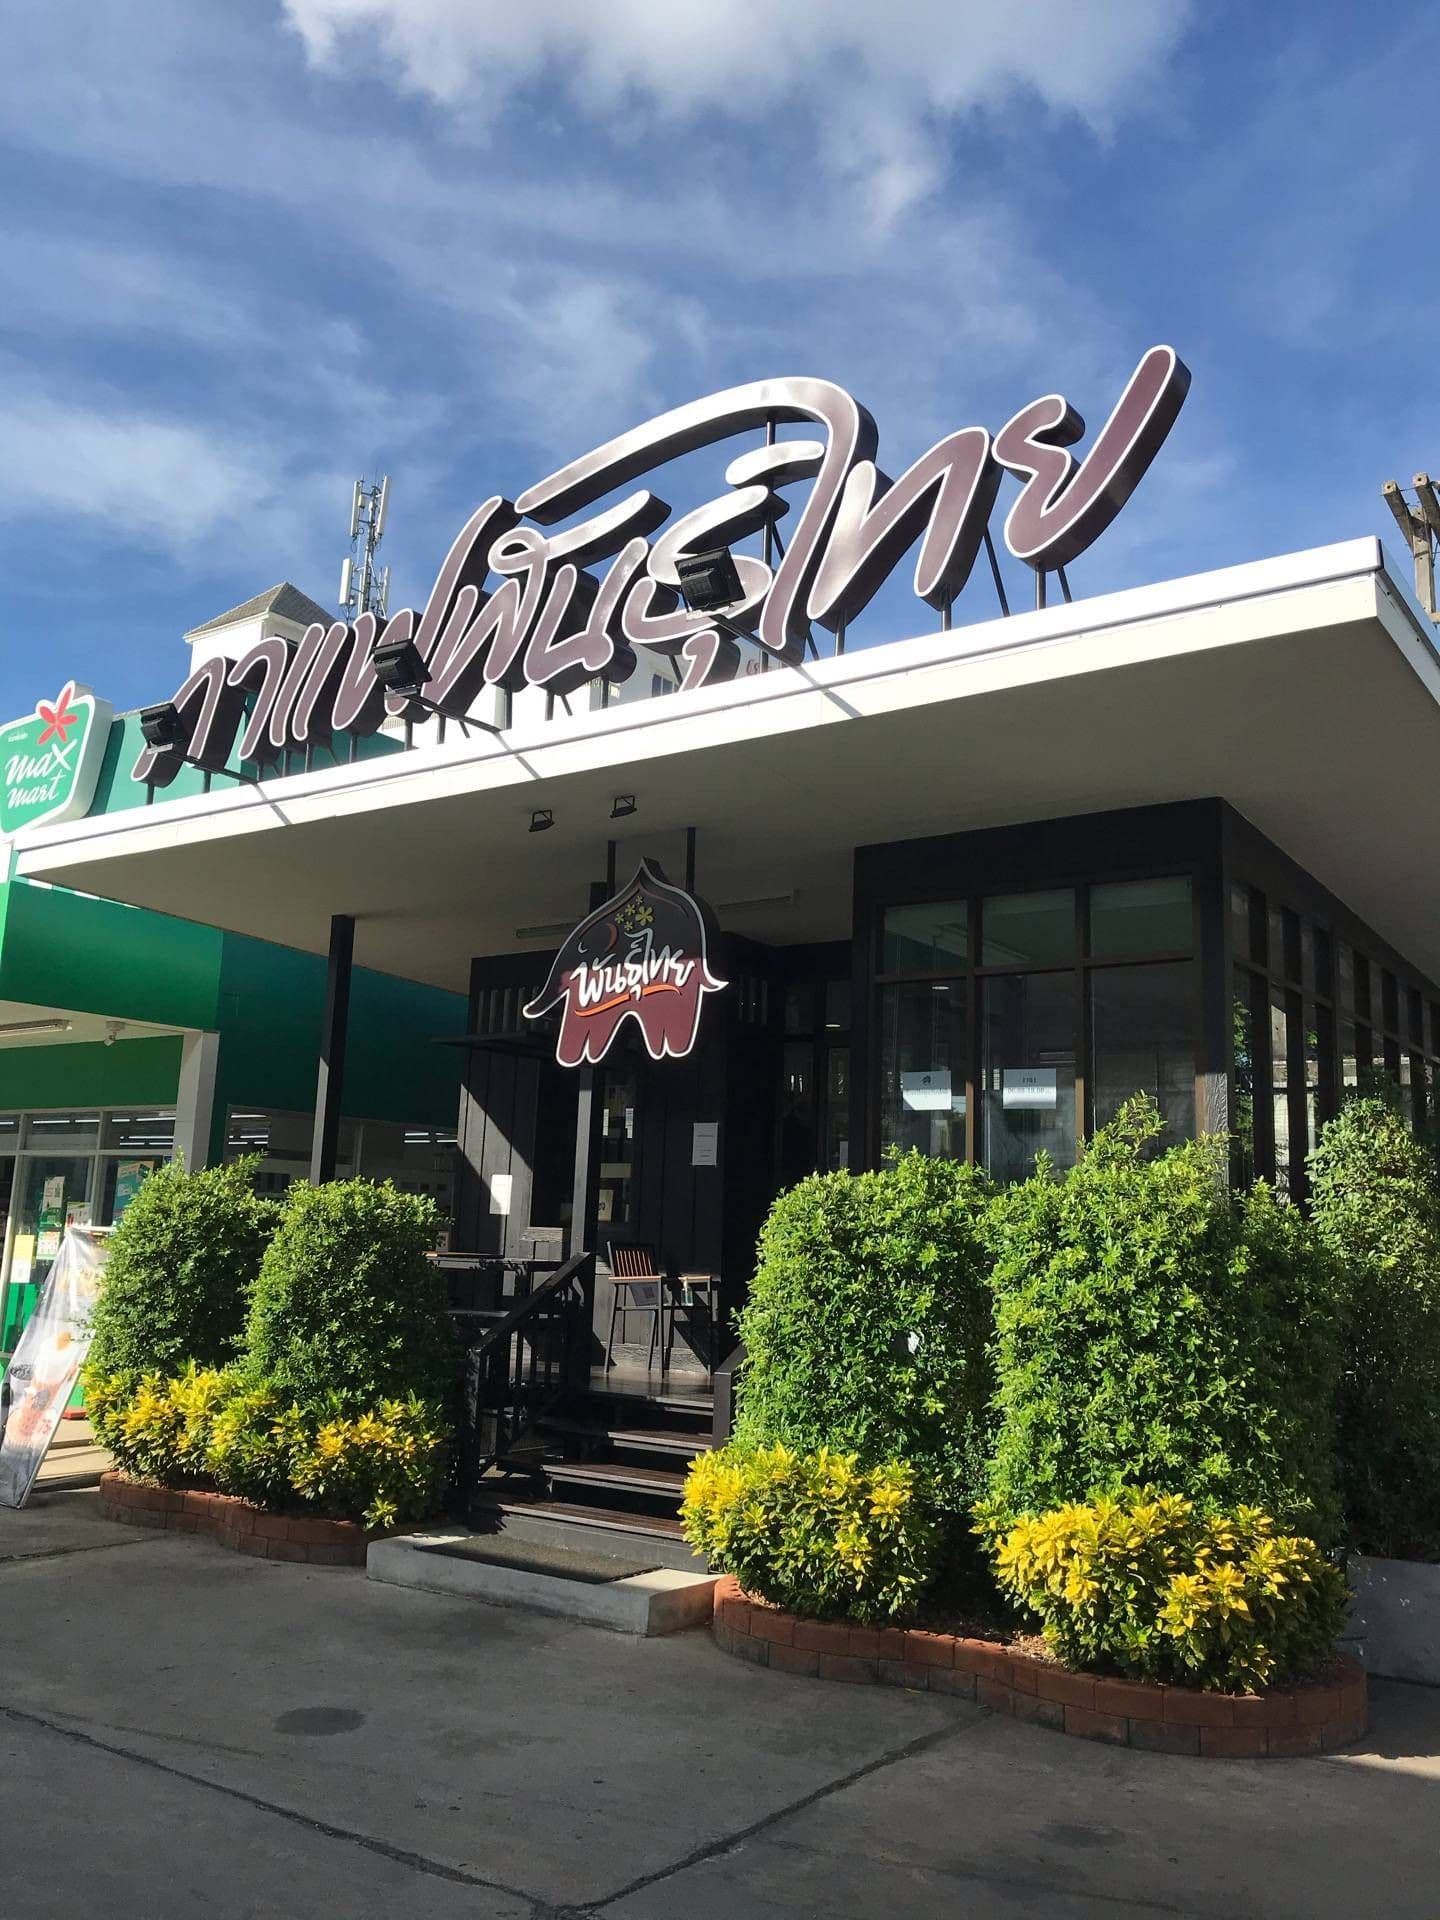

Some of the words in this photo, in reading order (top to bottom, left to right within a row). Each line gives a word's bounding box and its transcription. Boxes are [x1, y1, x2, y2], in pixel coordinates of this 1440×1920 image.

[7, 768, 67, 809] mart
[569, 927, 696, 1008] พันธุ์ไทย
